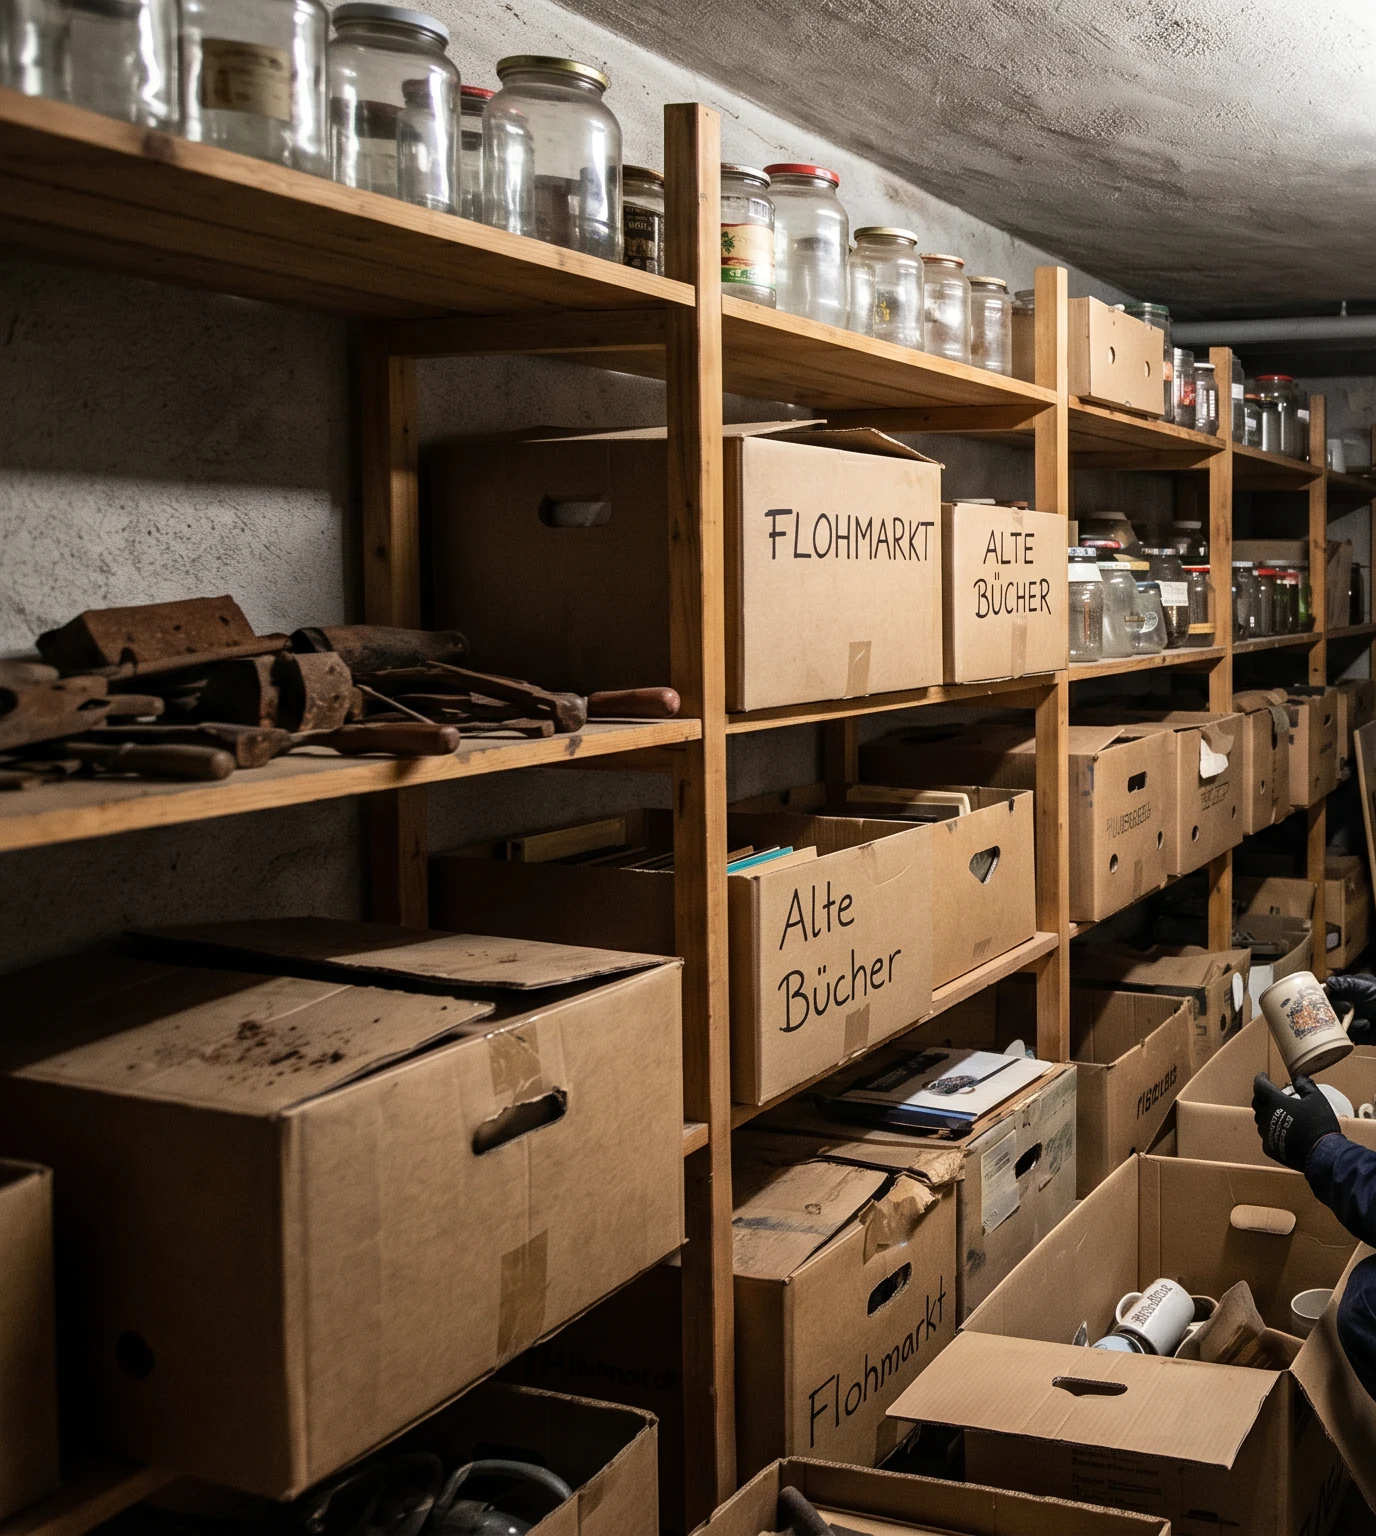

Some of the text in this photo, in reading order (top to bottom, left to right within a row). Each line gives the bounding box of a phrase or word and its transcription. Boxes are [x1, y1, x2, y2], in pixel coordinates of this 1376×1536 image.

[764, 508, 935, 562] FLOHMARKT
[983, 529, 1035, 565] ALTE
[973, 572, 1052, 619] BÜCHER
[779, 881, 855, 951] Alte
[777, 949, 902, 1033] Bücher
[808, 1275, 947, 1449] Flohmarkt
